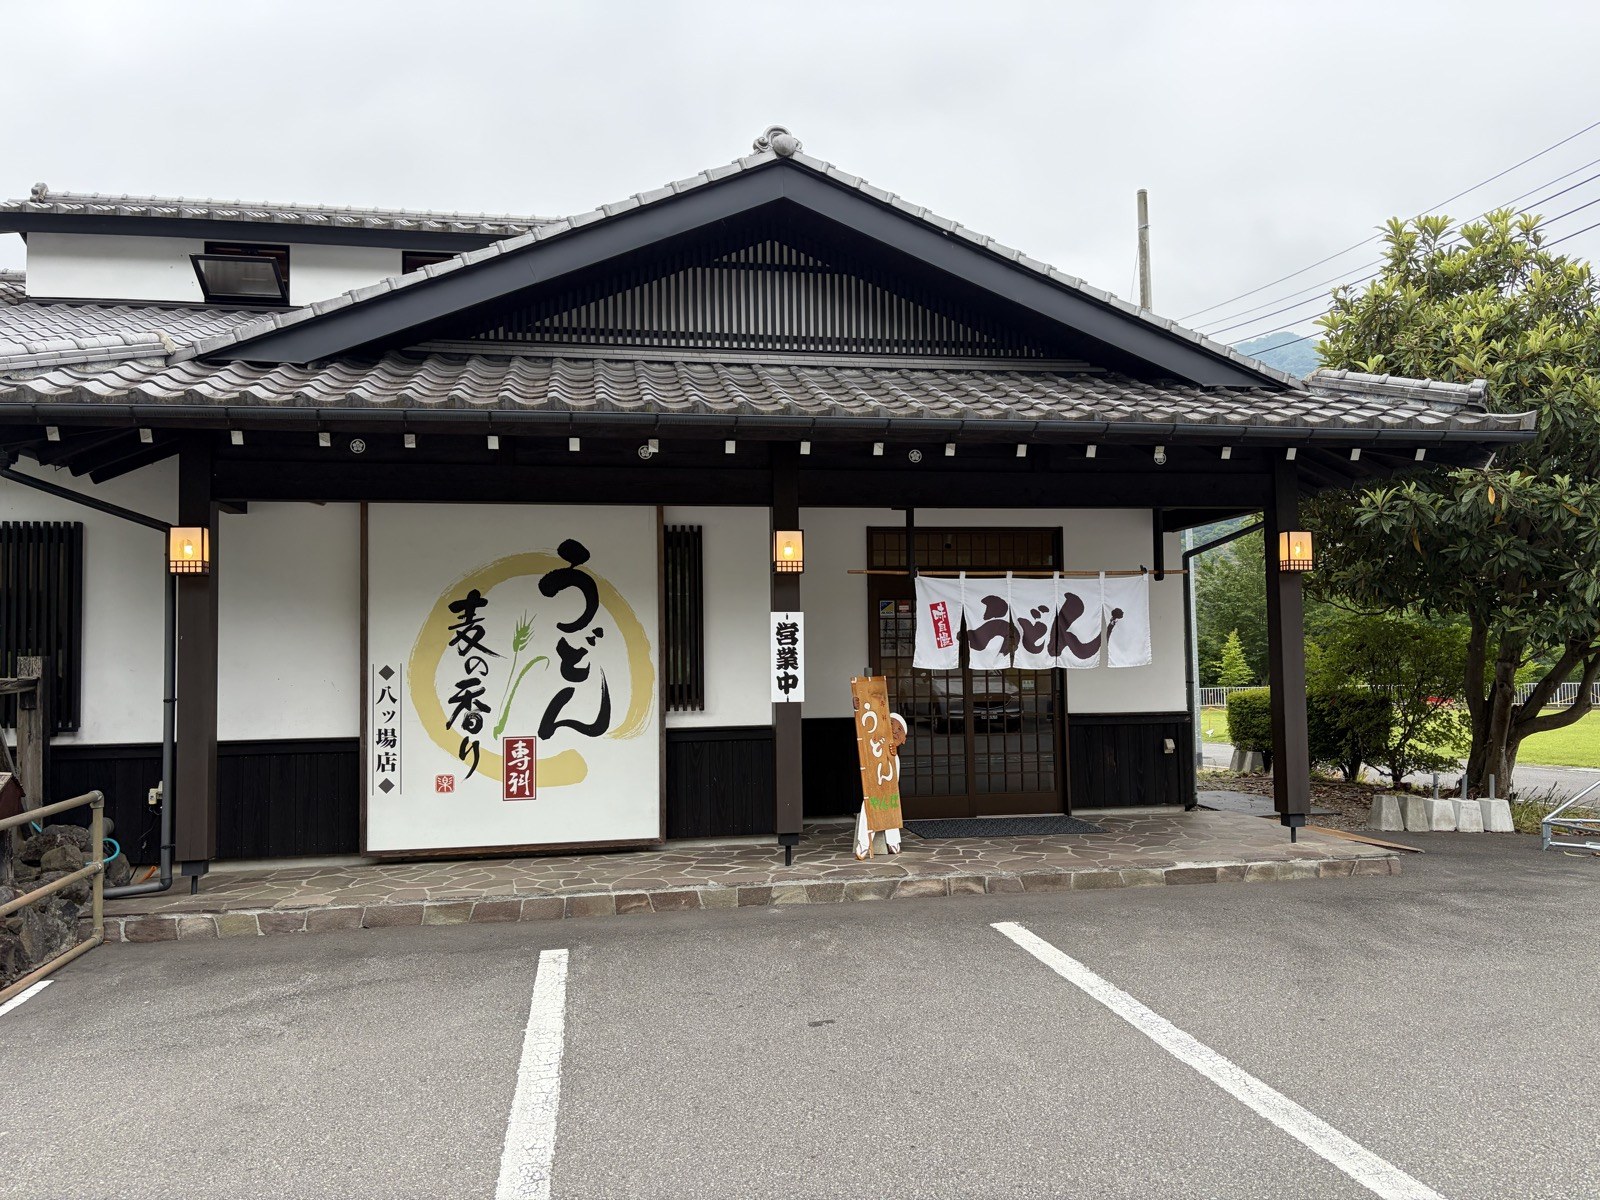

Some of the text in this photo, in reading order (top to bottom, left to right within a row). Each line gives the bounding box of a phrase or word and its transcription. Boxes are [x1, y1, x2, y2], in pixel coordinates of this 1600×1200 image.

[538, 538, 612, 741] うどん
[775, 622, 800, 695] 営業中
[957, 592, 1124, 660] うどん
[446, 588, 509, 783] 麦の香り
[507, 740, 533, 796] 専科
[861, 702, 894, 786] うどん
